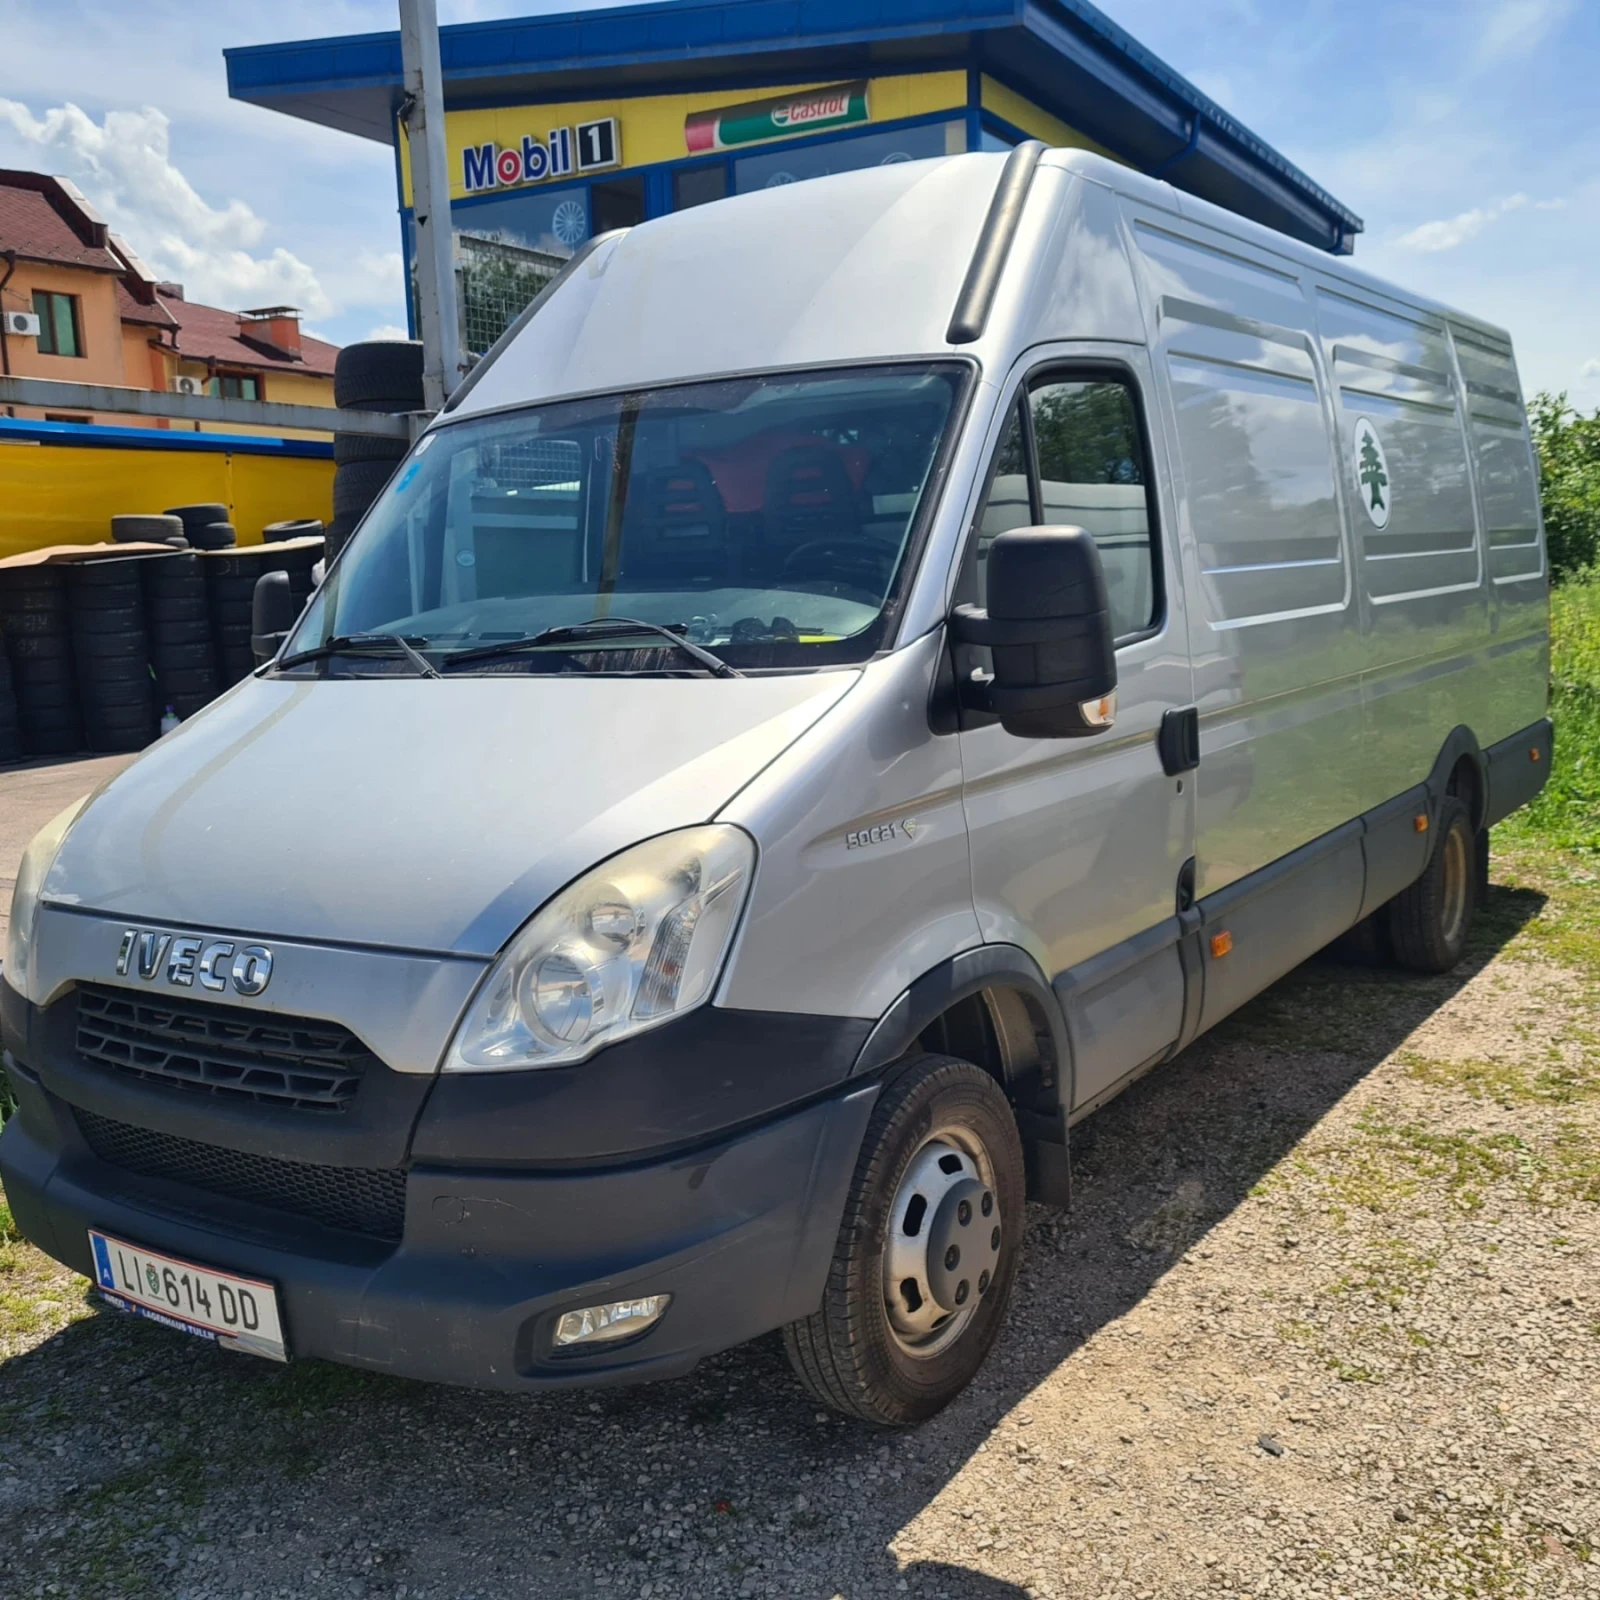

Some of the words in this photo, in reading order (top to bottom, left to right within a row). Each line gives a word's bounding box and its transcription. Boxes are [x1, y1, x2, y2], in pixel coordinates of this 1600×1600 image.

[790, 96, 846, 121] Castrol
[462, 126, 571, 192] Mobil
[846, 821, 898, 850] 50C21
[116, 928, 274, 997] IVECO
[103, 1268, 111, 1281] A
[118, 1250, 143, 1296] LI
[162, 1266, 212, 1319] 614
[217, 1283, 259, 1331] DD
